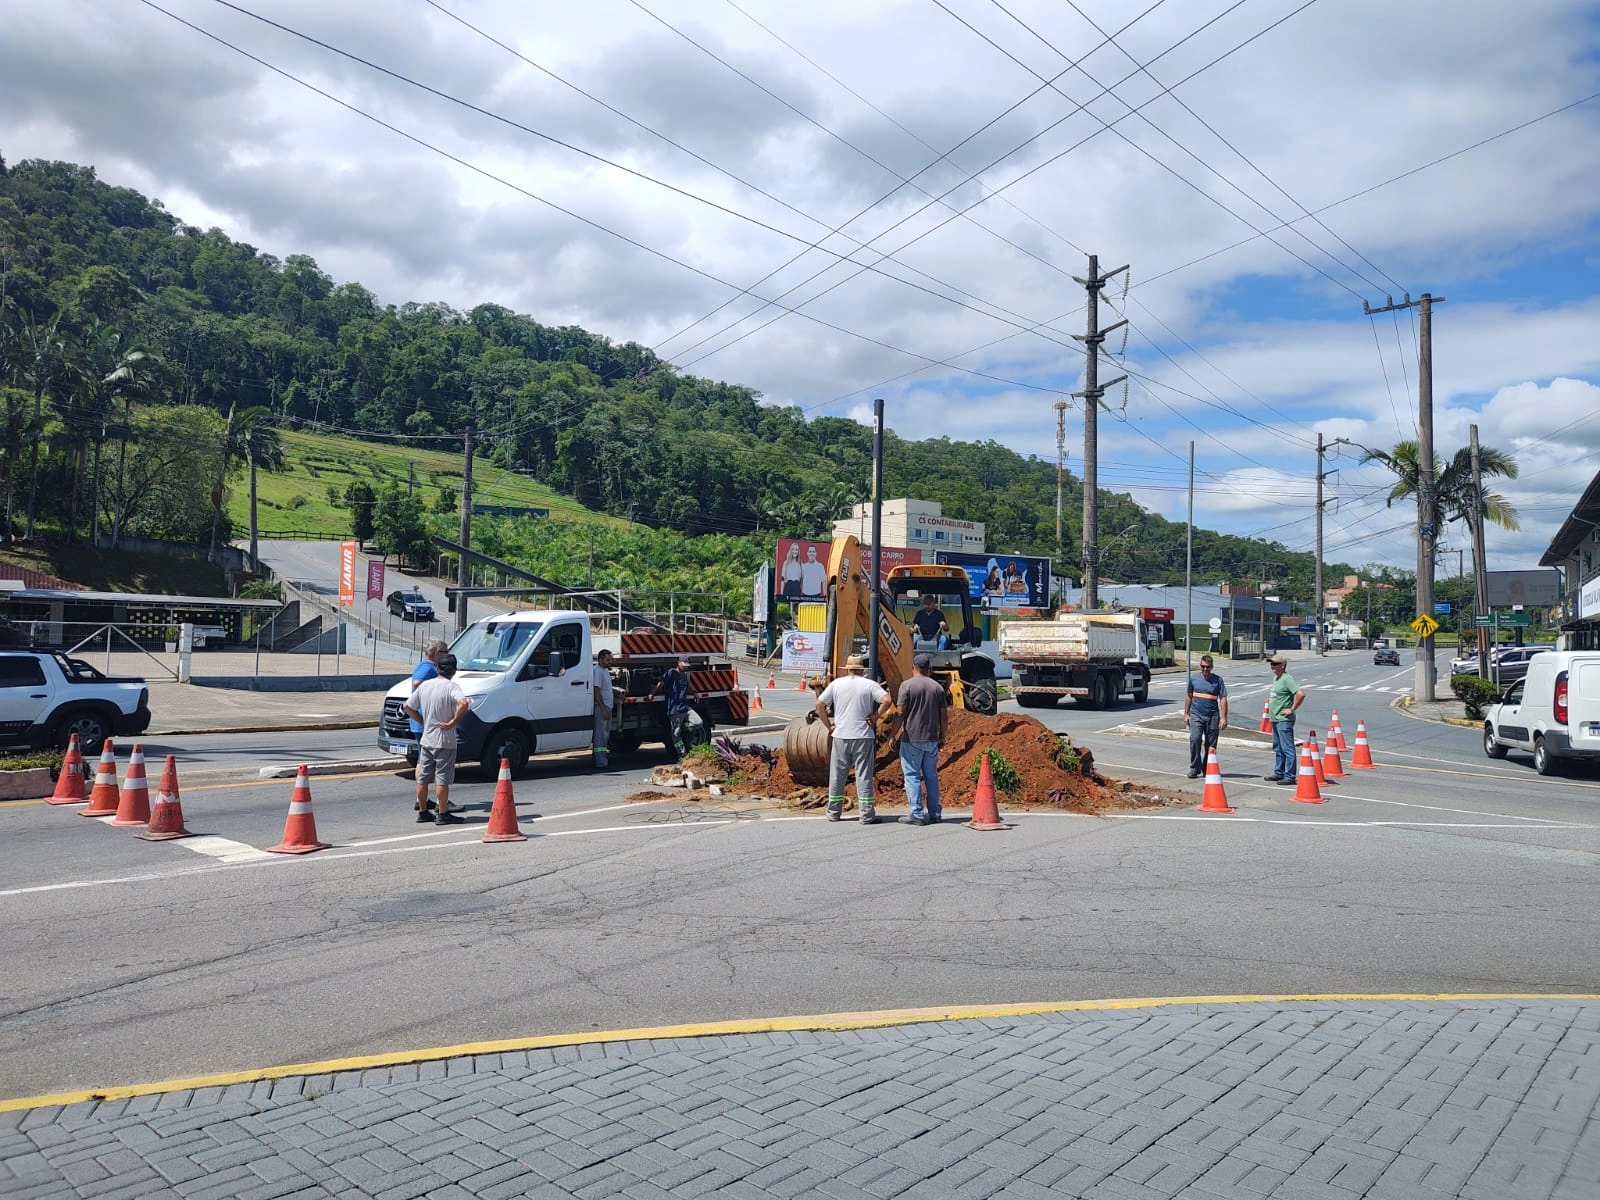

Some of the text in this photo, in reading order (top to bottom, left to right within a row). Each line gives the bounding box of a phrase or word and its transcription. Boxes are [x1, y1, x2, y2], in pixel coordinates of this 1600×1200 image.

[918, 516, 975, 530] CS CONTABILIDADE
[343, 549, 353, 591] JANIR
[371, 566, 381, 592] JANIR
